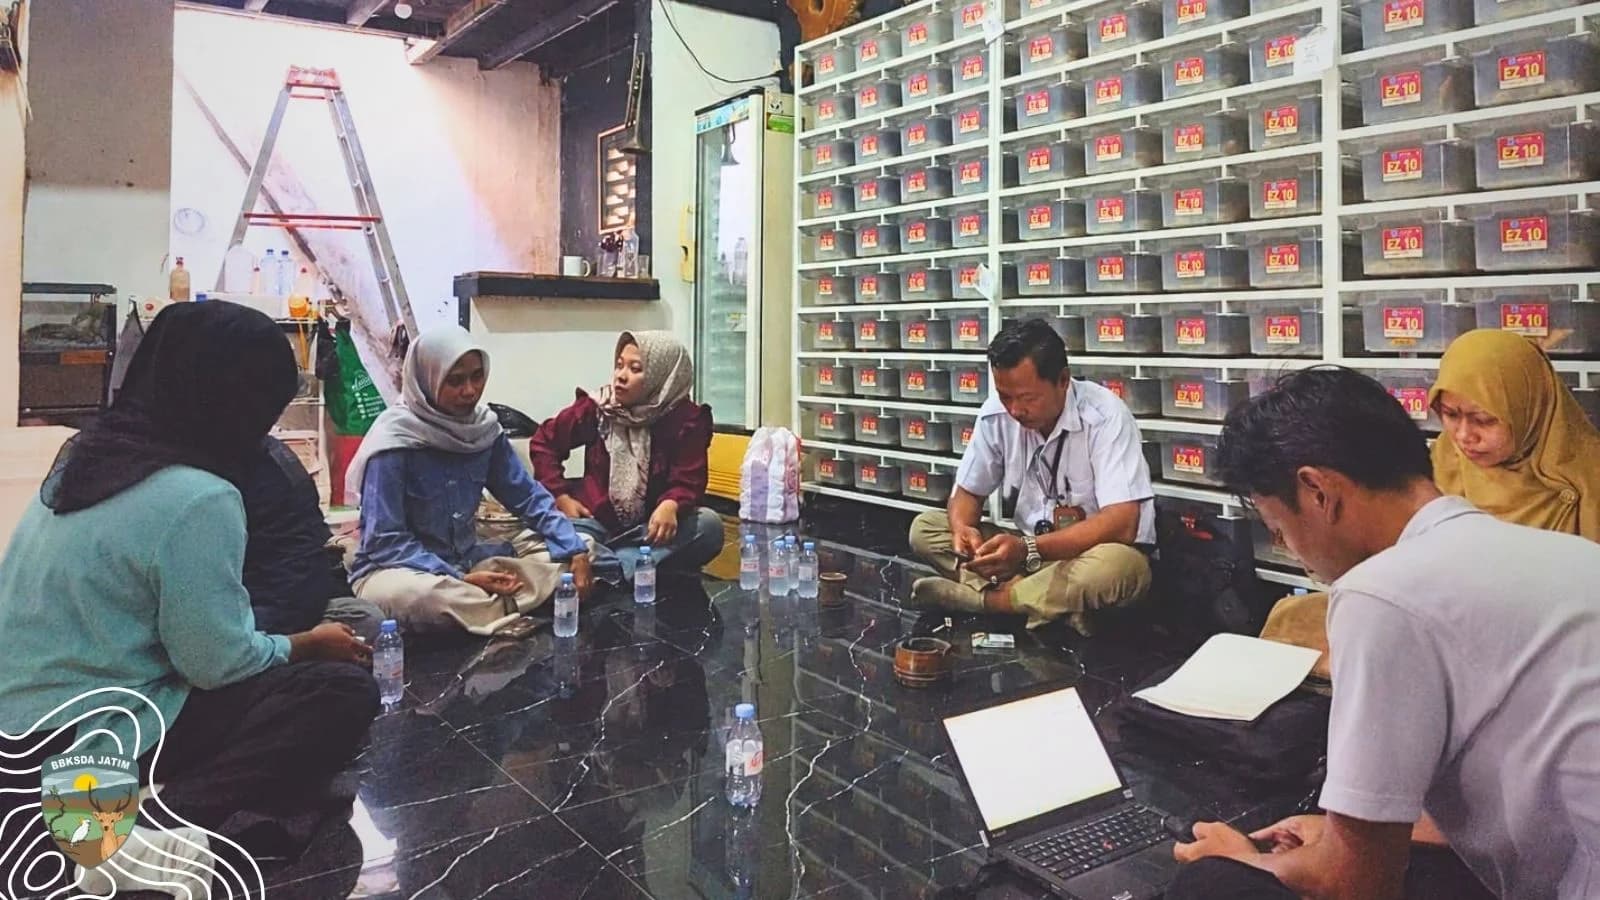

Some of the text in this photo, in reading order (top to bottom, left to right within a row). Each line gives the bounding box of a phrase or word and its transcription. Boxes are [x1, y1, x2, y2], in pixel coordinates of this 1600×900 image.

[1388, 6, 1419, 22] EZ 10
[1268, 44, 1295, 59] EZ 10
[1504, 62, 1540, 80] EZ 10
[1386, 82, 1416, 98] EZ 10
[1268, 116, 1294, 128] EZ 10
[1502, 144, 1540, 159] EZ 10
[1386, 158, 1418, 173] EZ 10
[1268, 189, 1294, 200] EZ 10
[1506, 228, 1542, 242] EZ 10
[1386, 236, 1418, 250] EZ 10
[1269, 254, 1295, 266] EZ 10
[1388, 317, 1418, 330] EZ 10
[1506, 314, 1542, 328] EZ 10
[1270, 326, 1296, 336] EZ 10
[1408, 398, 1422, 412] 10
